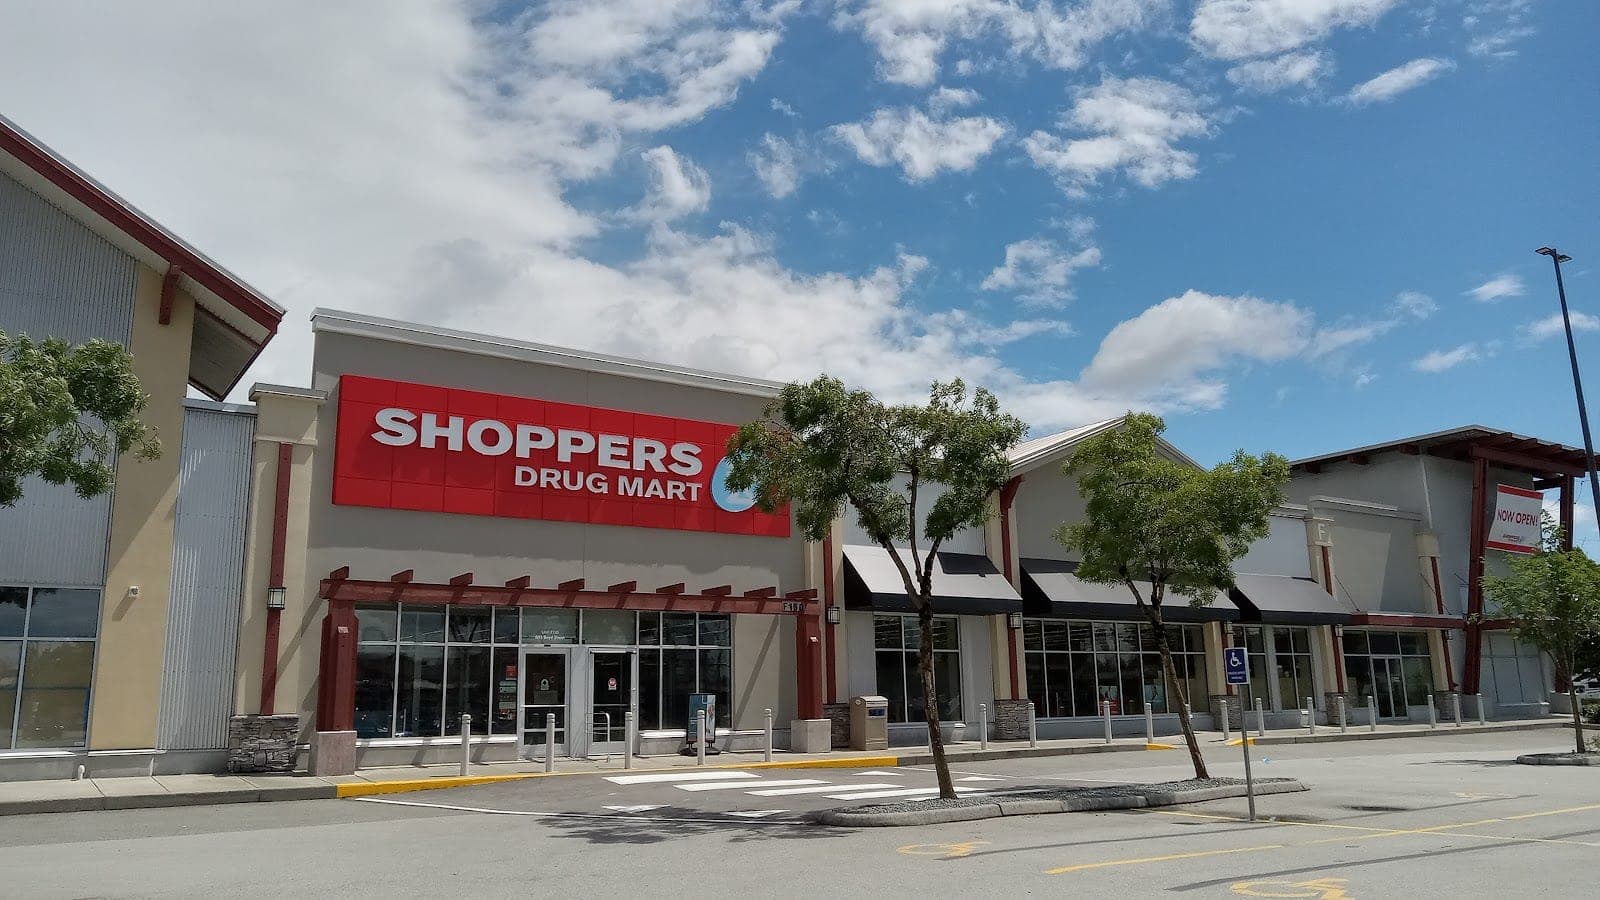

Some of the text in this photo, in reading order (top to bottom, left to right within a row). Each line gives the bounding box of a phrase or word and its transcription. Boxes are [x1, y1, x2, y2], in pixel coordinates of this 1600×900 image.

[371, 407, 703, 477] SHOPPERS
[514, 465, 703, 502] DRUG MART
[1497, 509, 1538, 527] NOW OPEN!
